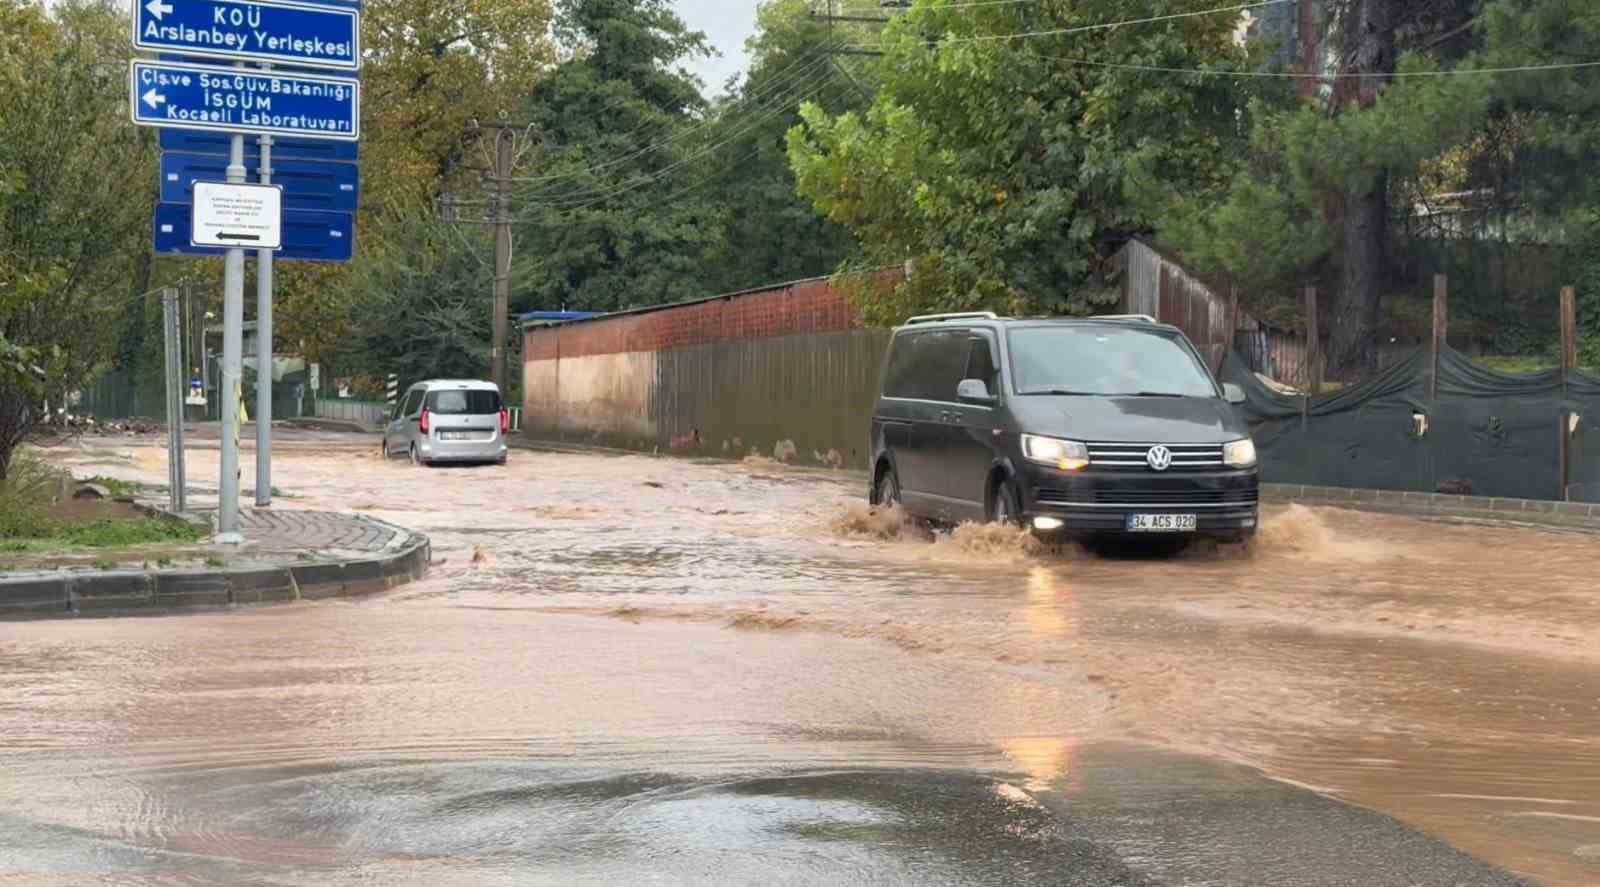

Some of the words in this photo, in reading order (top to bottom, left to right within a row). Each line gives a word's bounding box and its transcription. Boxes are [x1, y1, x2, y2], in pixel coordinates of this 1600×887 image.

[214, 6, 261, 27] KOÜ
[144, 20, 248, 50] Arslanbey
[254, 31, 350, 57] Yerleşkesi
[204, 89, 271, 111] İSGÜM
[167, 104, 232, 122] Kocaeli
[241, 110, 350, 131] Laboratuvarı
[1135, 515, 1147, 527] 34
[1151, 515, 1172, 527] ACS
[1175, 515, 1195, 527] 020
